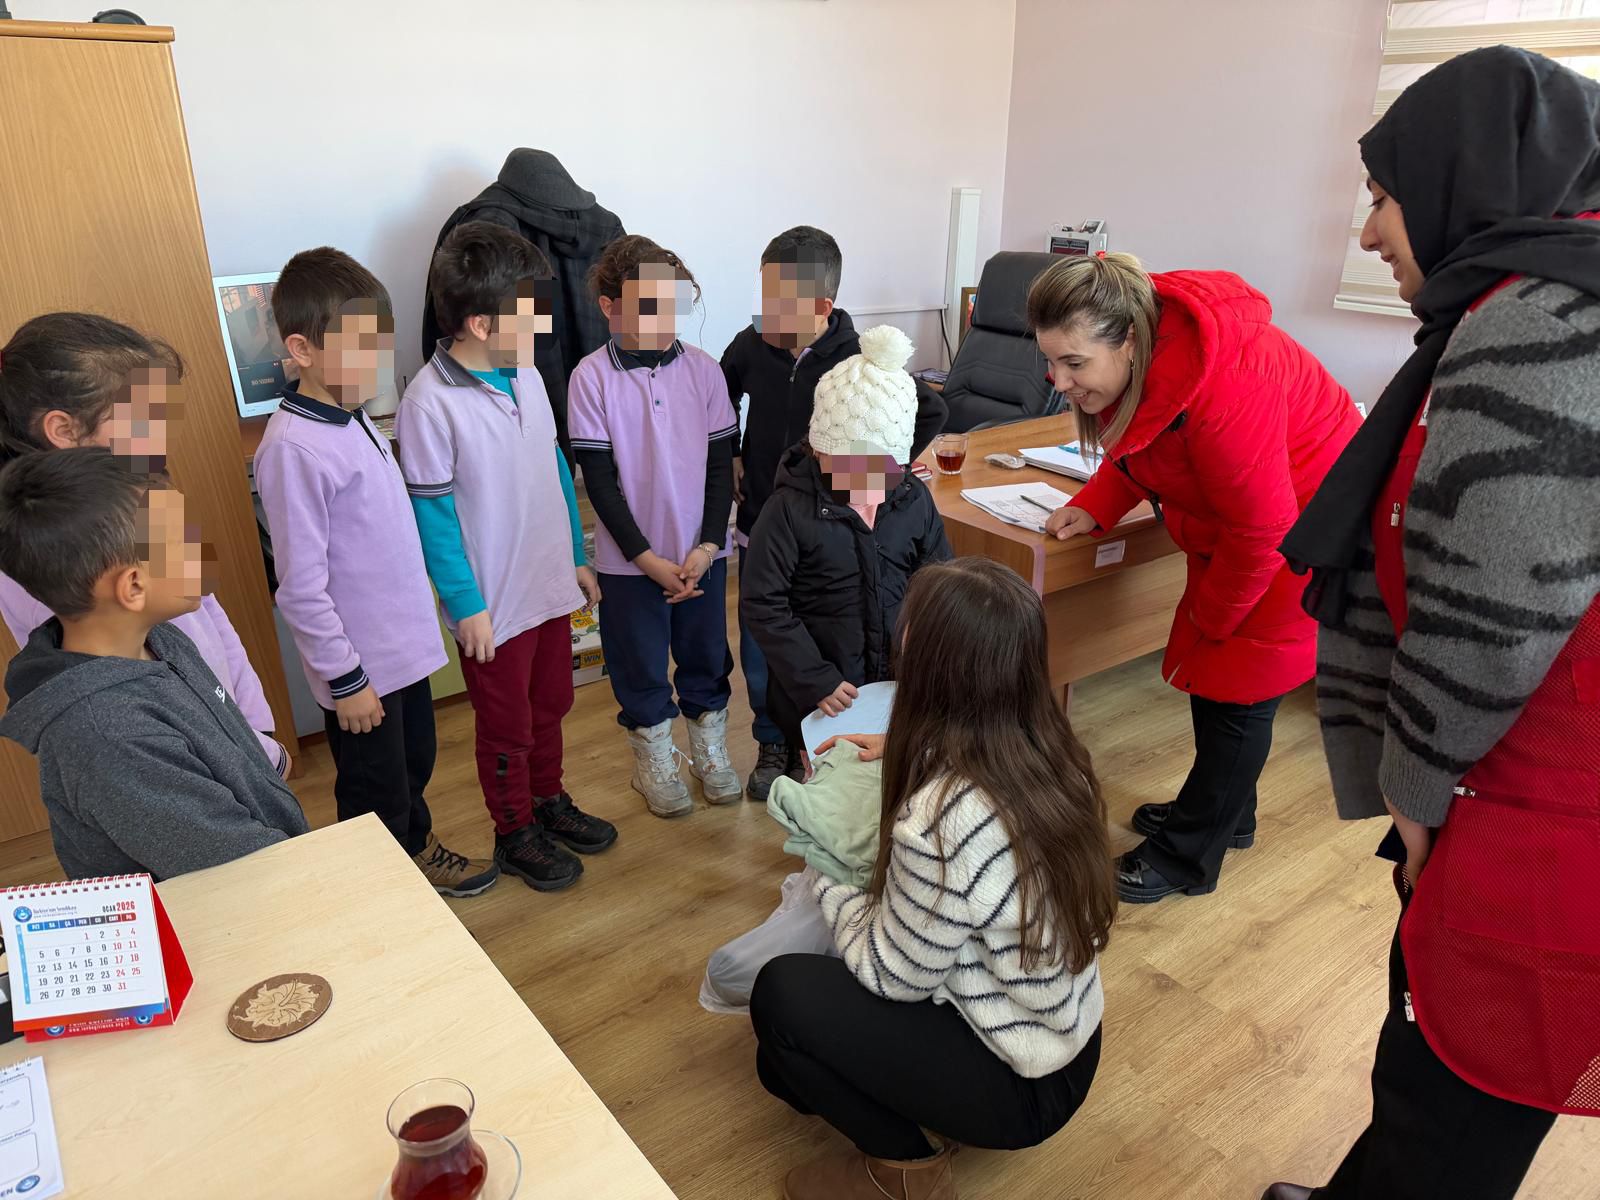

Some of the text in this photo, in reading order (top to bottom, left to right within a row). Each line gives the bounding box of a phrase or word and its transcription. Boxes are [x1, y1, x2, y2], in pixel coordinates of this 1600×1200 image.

[116, 901, 136, 911] 2026
[113, 942, 122, 950] 10
[129, 940, 137, 948] 11
[37, 953, 140, 973] 12 13 14 15 16 17 18
[39, 966, 141, 986] 19 20 21 22 23 24 25
[40, 982, 127, 1000] 26 27 28 29 30 31
